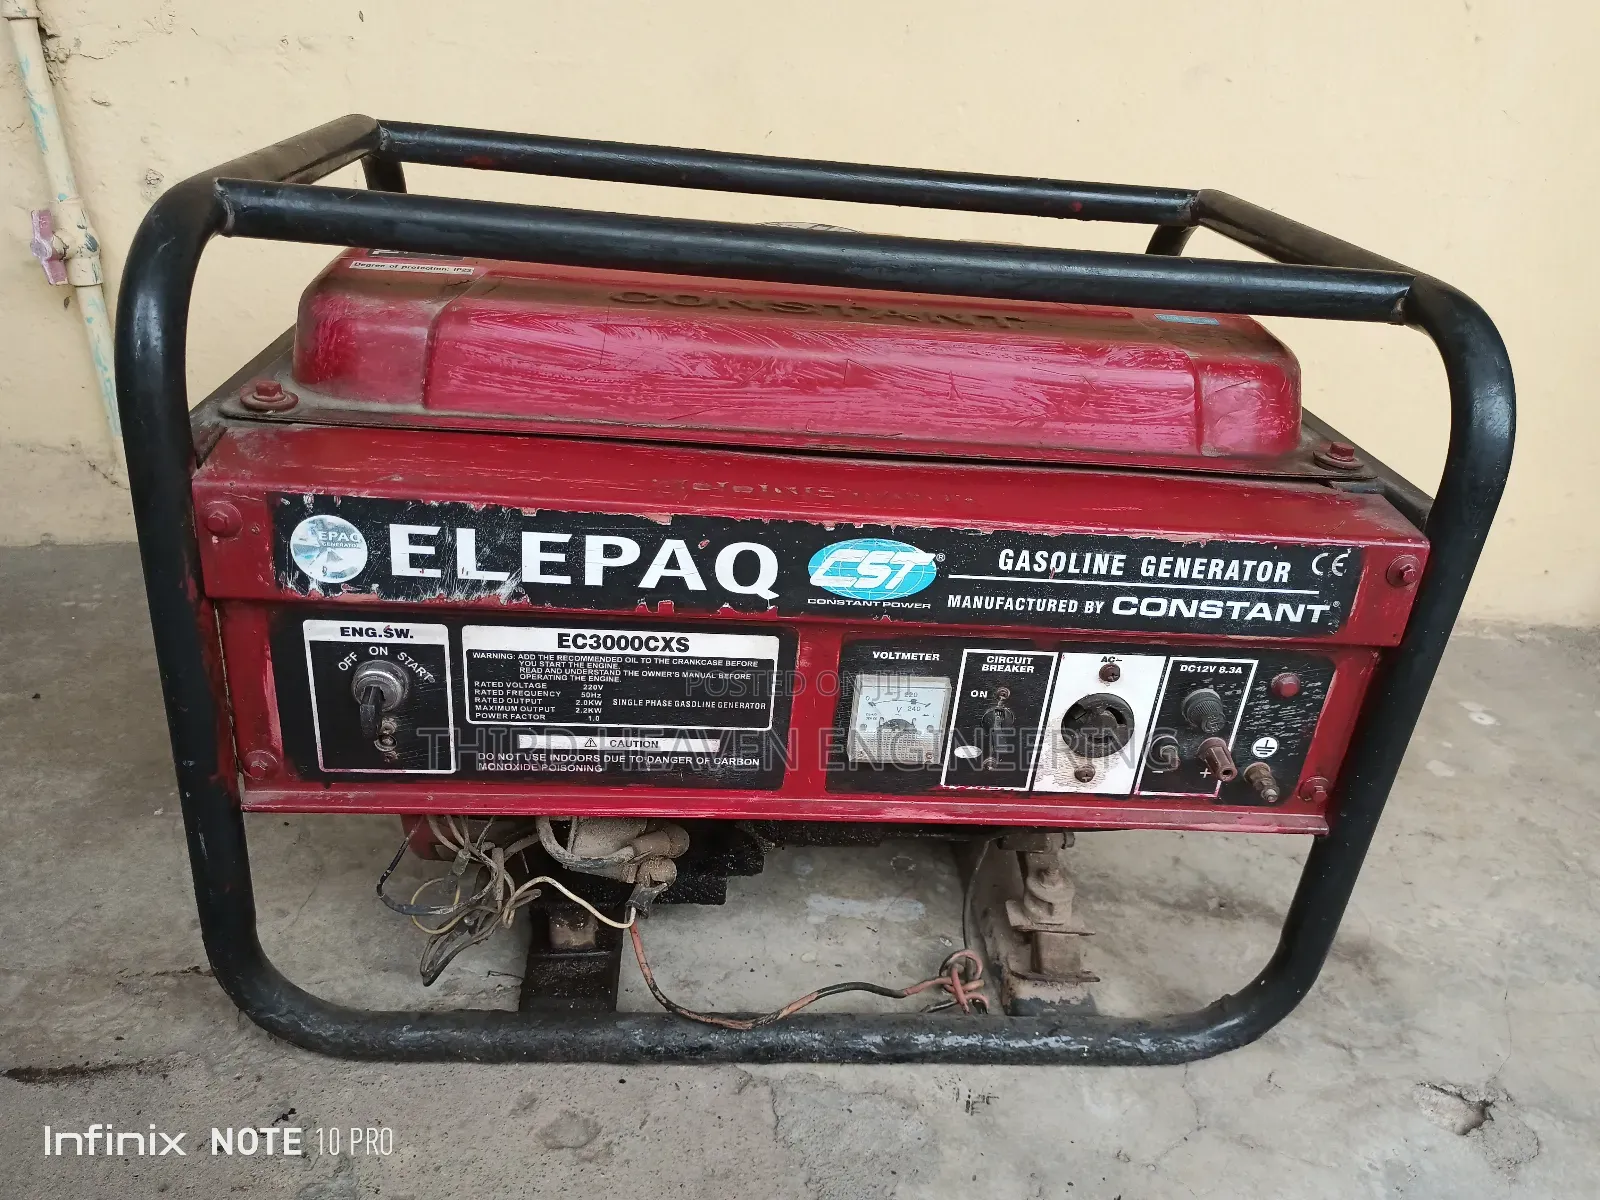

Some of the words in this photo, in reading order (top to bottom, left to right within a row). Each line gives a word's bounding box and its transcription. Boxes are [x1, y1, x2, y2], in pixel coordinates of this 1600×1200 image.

[389, 523, 780, 600] ELEPAQ
[998, 549, 1127, 576] GASOLINE
[1140, 555, 1292, 583] GENERATOR
[807, 598, 881, 607] CONSTANT
[882, 601, 931, 609] POWER
[947, 594, 1079, 613] MANUFACTURED
[1084, 600, 1105, 614] BY
[339, 626, 414, 639] ENG.SW.
[557, 632, 690, 653] EC3000CXS
[368, 646, 389, 656] ON
[872, 651, 941, 661] VOLTMETER
[338, 651, 358, 671] OFF
[472, 652, 516, 660] WARNING:
[556, 654, 623, 663] RECOMMENDED
[672, 658, 723, 666] CRANKCASE
[725, 660, 759, 668] BEFORE
[986, 655, 1034, 665] CIRCUIT
[397, 652, 436, 684] START
[587, 662, 621, 670] ENGINE.
[981, 664, 1035, 674] BREAKER
[1179, 664, 1217, 674] DC12V
[1218, 666, 1243, 674] 8.3A
[564, 668, 621, 676] UNDERSTAND
[641, 670, 680, 678] OWNER'S
[681, 671, 717, 679] MANUAL
[718, 672, 751, 680] BEFORE
[570, 674, 586, 682] THE
[588, 675, 622, 683] ENGINE.
[506, 689, 562, 697] FREQUENCY
[970, 690, 988, 698] ON
[506, 697, 543, 705] OUTPUT
[645, 699, 673, 707] PHASE
[674, 700, 716, 709] GASOLINE
[717, 701, 766, 710] GENERATOR
[519, 705, 556, 713] OUTPUT
[475, 712, 509, 720] POWER
[510, 713, 546, 721] FACTOR
[609, 739, 659, 749] CAUTION
[478, 752, 495, 761] DO
[498, 753, 521, 761] NOT
[524, 753, 547, 762] USE
[550, 754, 600, 763] INDOORS
[603, 755, 626, 763] DUE
[629, 755, 643, 763] TO
[646, 755, 693, 764] DANGER
[696, 757, 710, 765] OF
[713, 757, 760, 766] CARBON
[478, 763, 538, 771] MONOXIDE
[541, 764, 603, 773] POISONING
